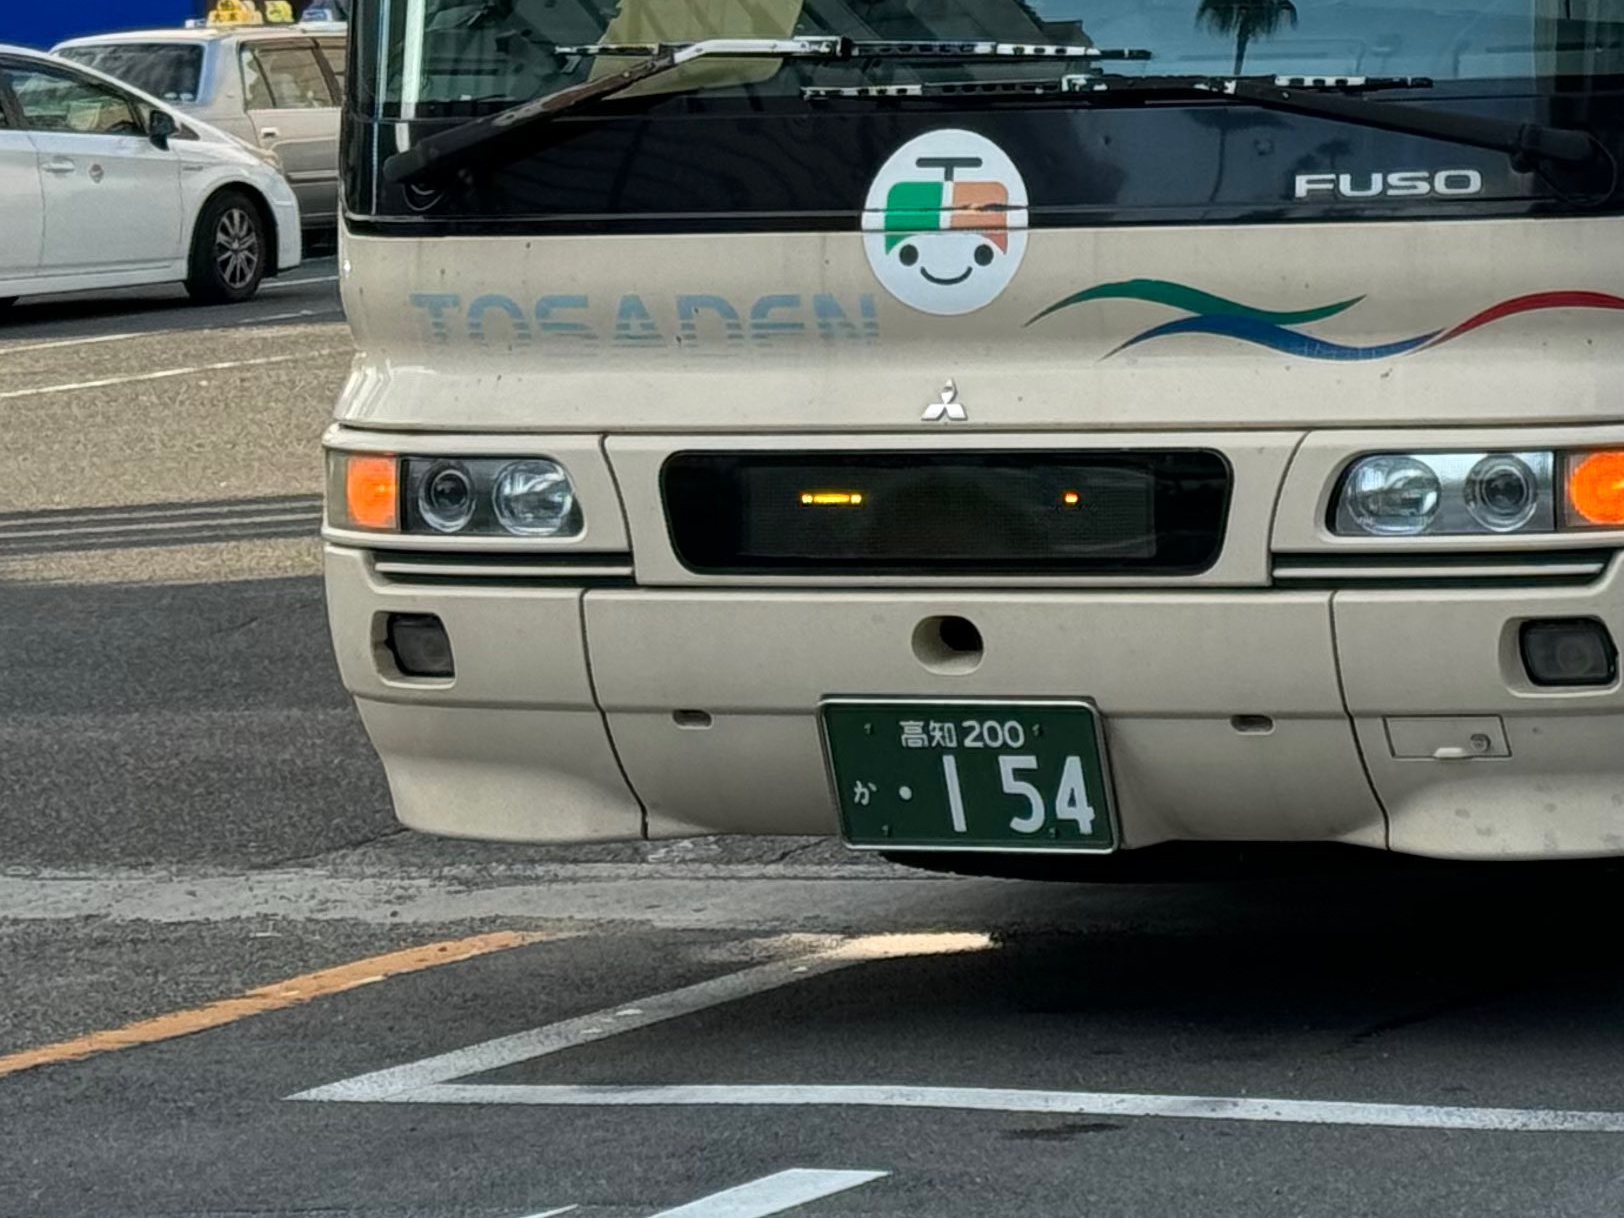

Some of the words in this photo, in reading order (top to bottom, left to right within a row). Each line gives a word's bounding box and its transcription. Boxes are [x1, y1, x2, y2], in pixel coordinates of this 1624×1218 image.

[1294, 169, 1482, 198] FUSO
[409, 293, 880, 358] TOSADEN
[900, 720, 957, 748] 高知
[961, 720, 1025, 748] 200
[854, 780, 878, 806] か
